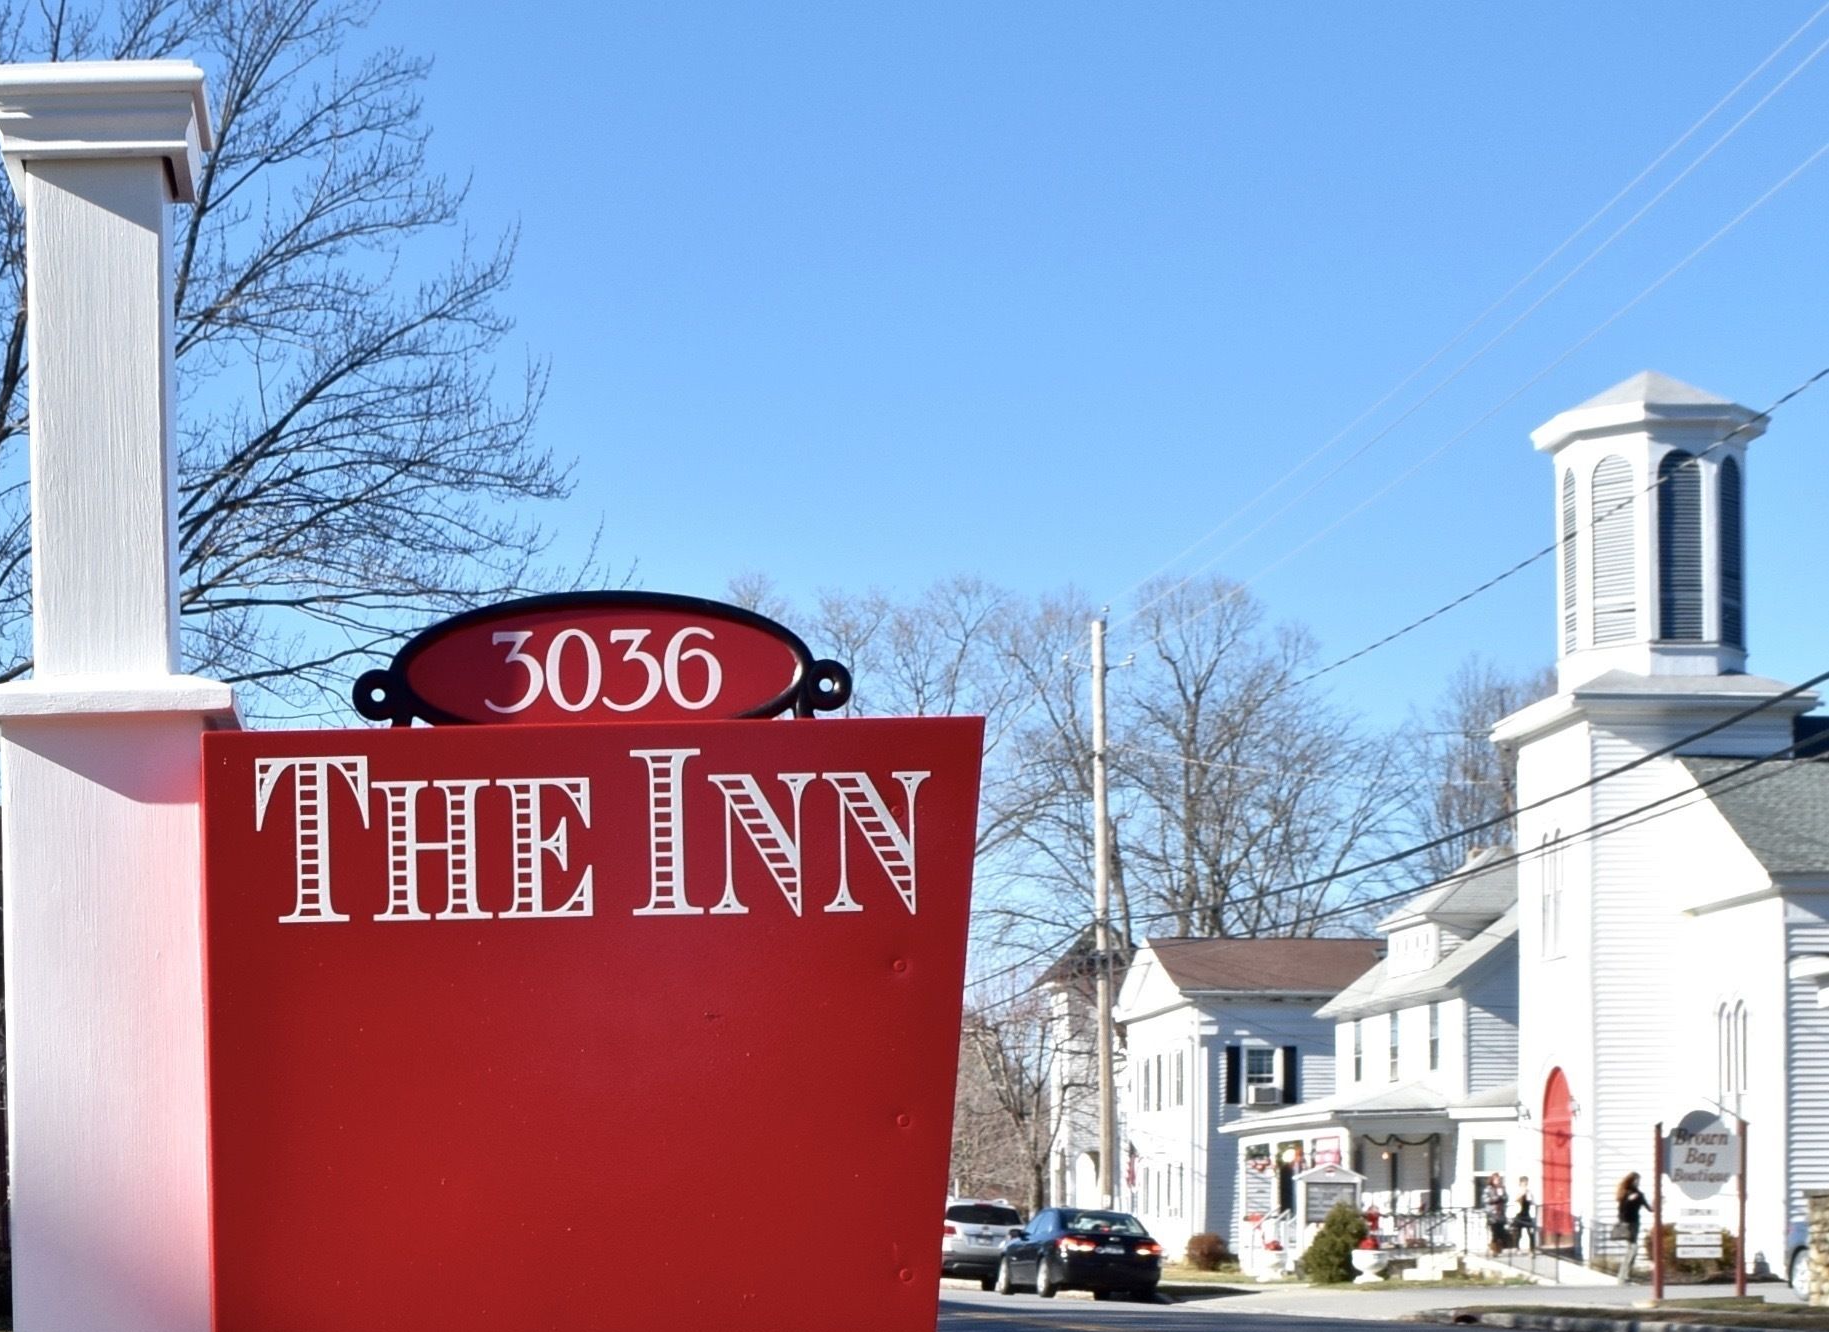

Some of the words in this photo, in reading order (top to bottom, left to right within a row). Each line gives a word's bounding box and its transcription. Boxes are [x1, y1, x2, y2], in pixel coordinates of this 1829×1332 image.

[484, 627, 722, 712] 3036
[255, 756, 593, 923] THE
[629, 748, 931, 917] INN
[1684, 1148, 1716, 1167] Bag
